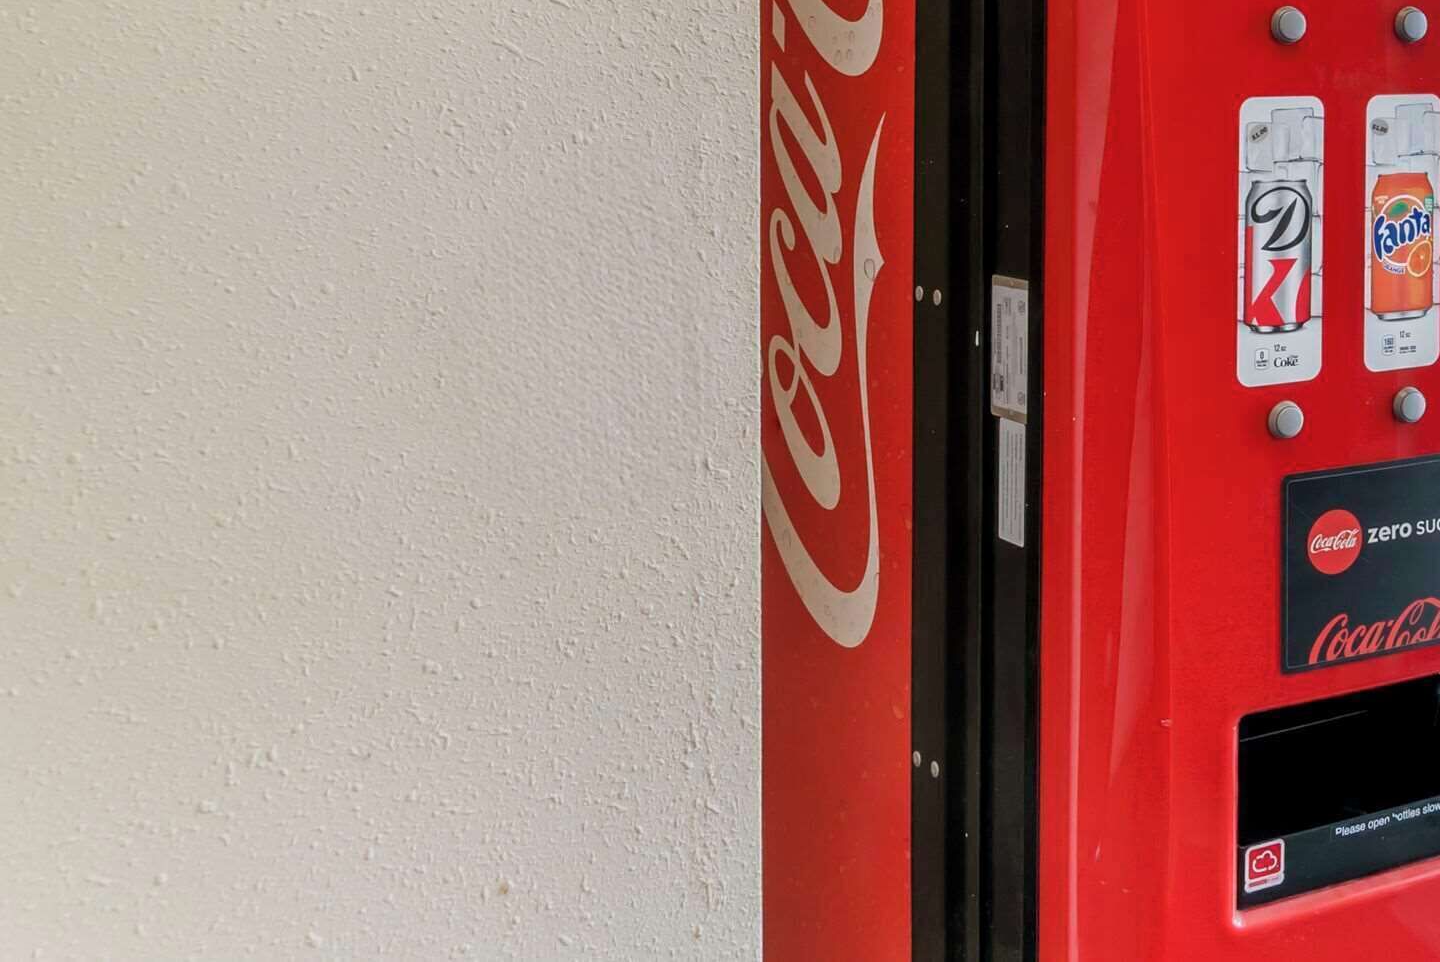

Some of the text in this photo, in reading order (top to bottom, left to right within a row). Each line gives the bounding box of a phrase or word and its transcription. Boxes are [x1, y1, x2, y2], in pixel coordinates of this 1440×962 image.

[1310, 527, 1360, 554] Coca-Cola
[1367, 522, 1413, 544] zero
[1335, 822, 1367, 837] Please
[1367, 816, 1391, 831] open
